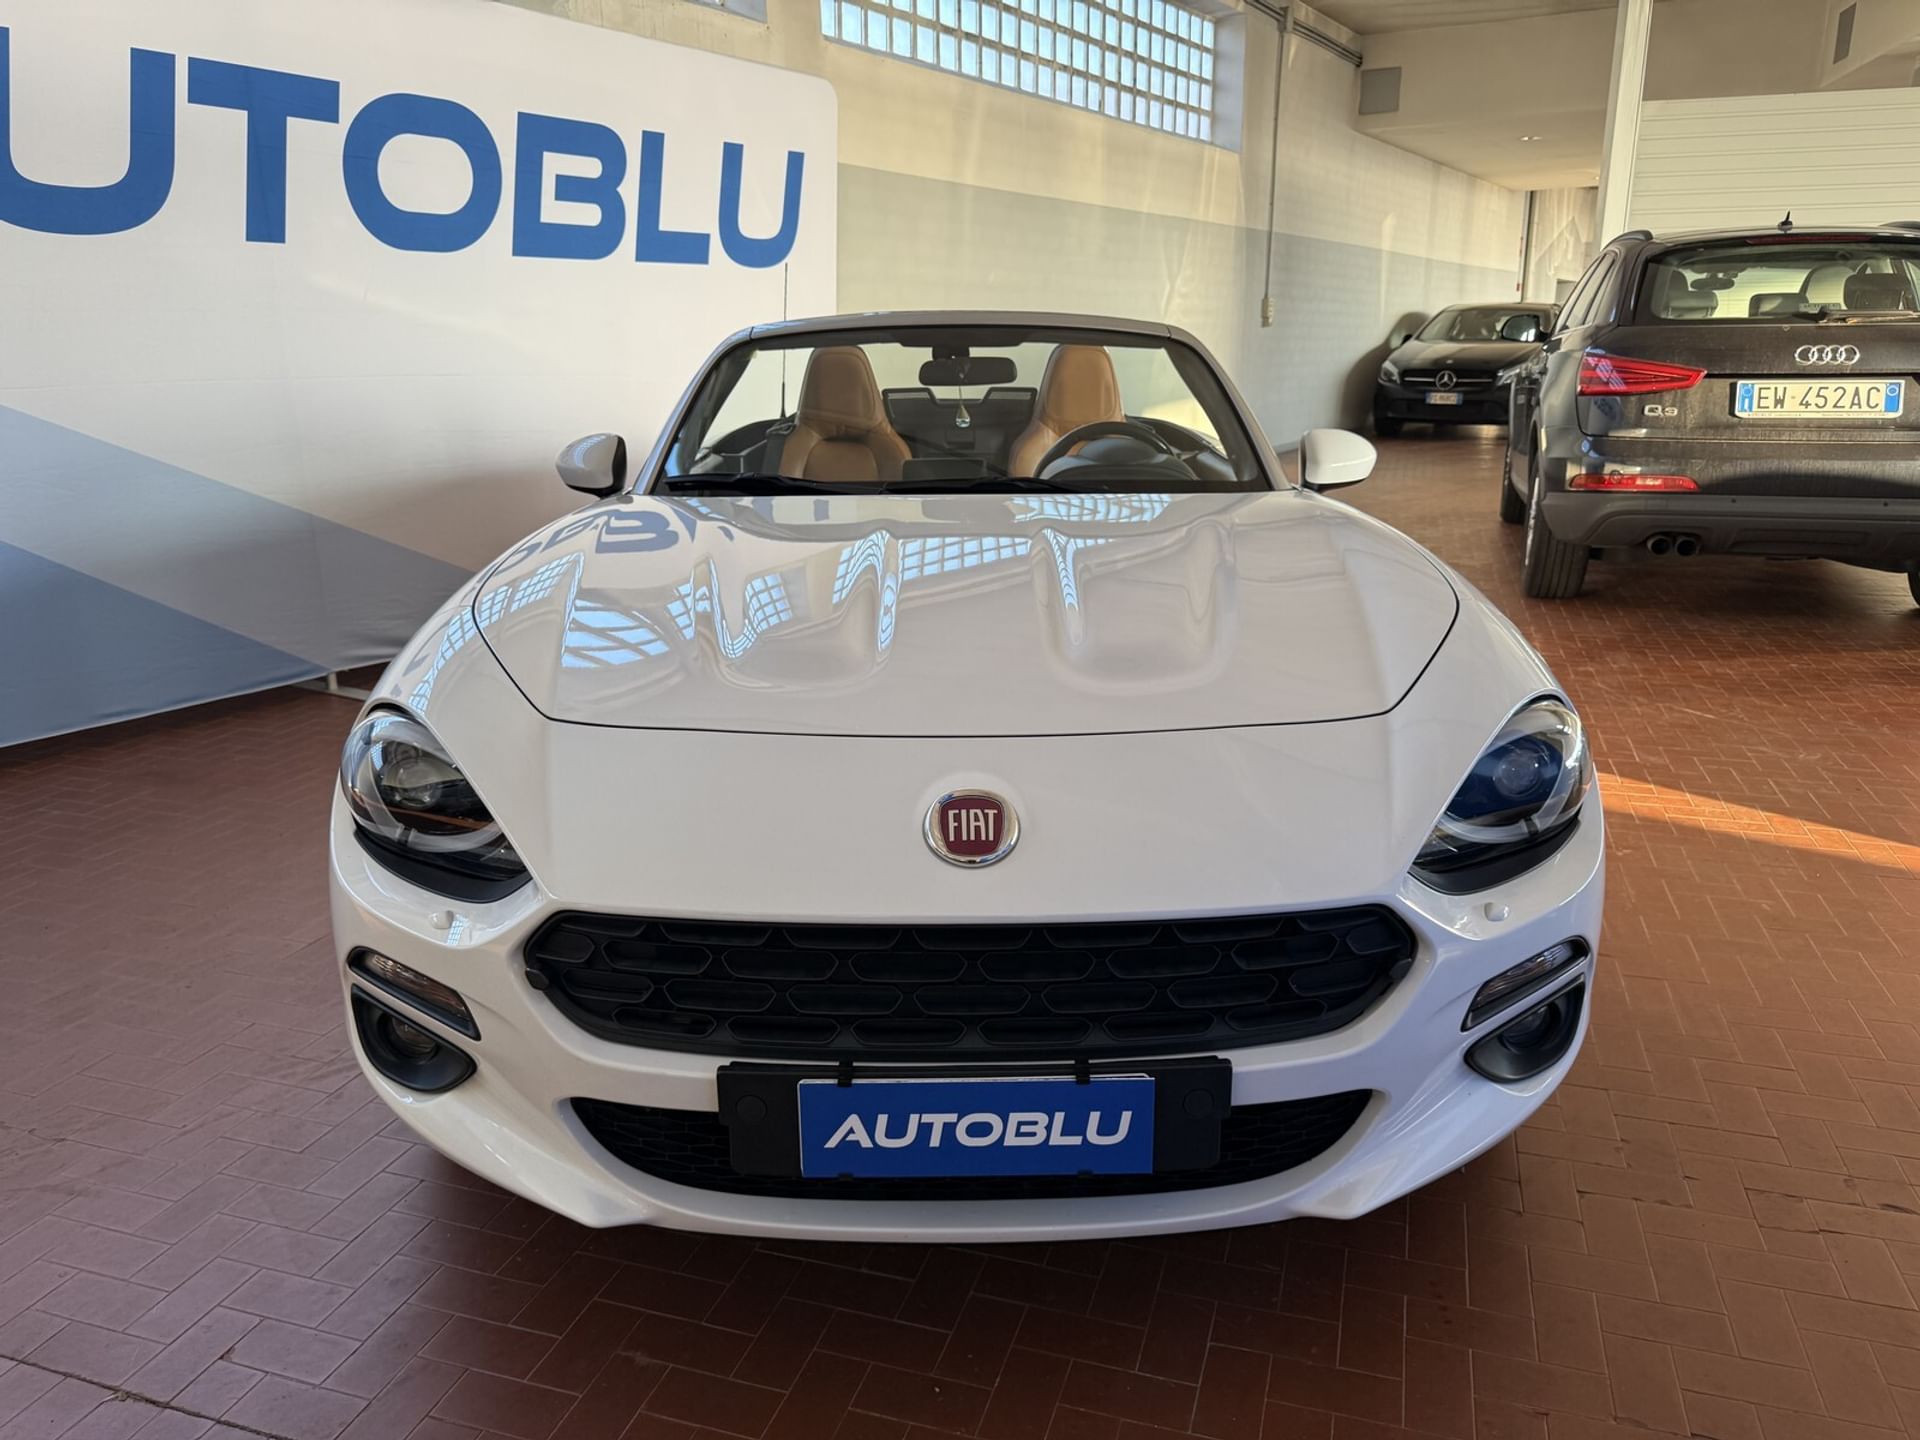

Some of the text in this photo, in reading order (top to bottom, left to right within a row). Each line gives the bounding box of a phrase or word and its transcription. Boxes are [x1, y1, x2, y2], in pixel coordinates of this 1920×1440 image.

[1643, 404, 1678, 418] Q3
[947, 808, 999, 842] FIAT
[823, 1110, 1133, 1149] AUTOBLU
